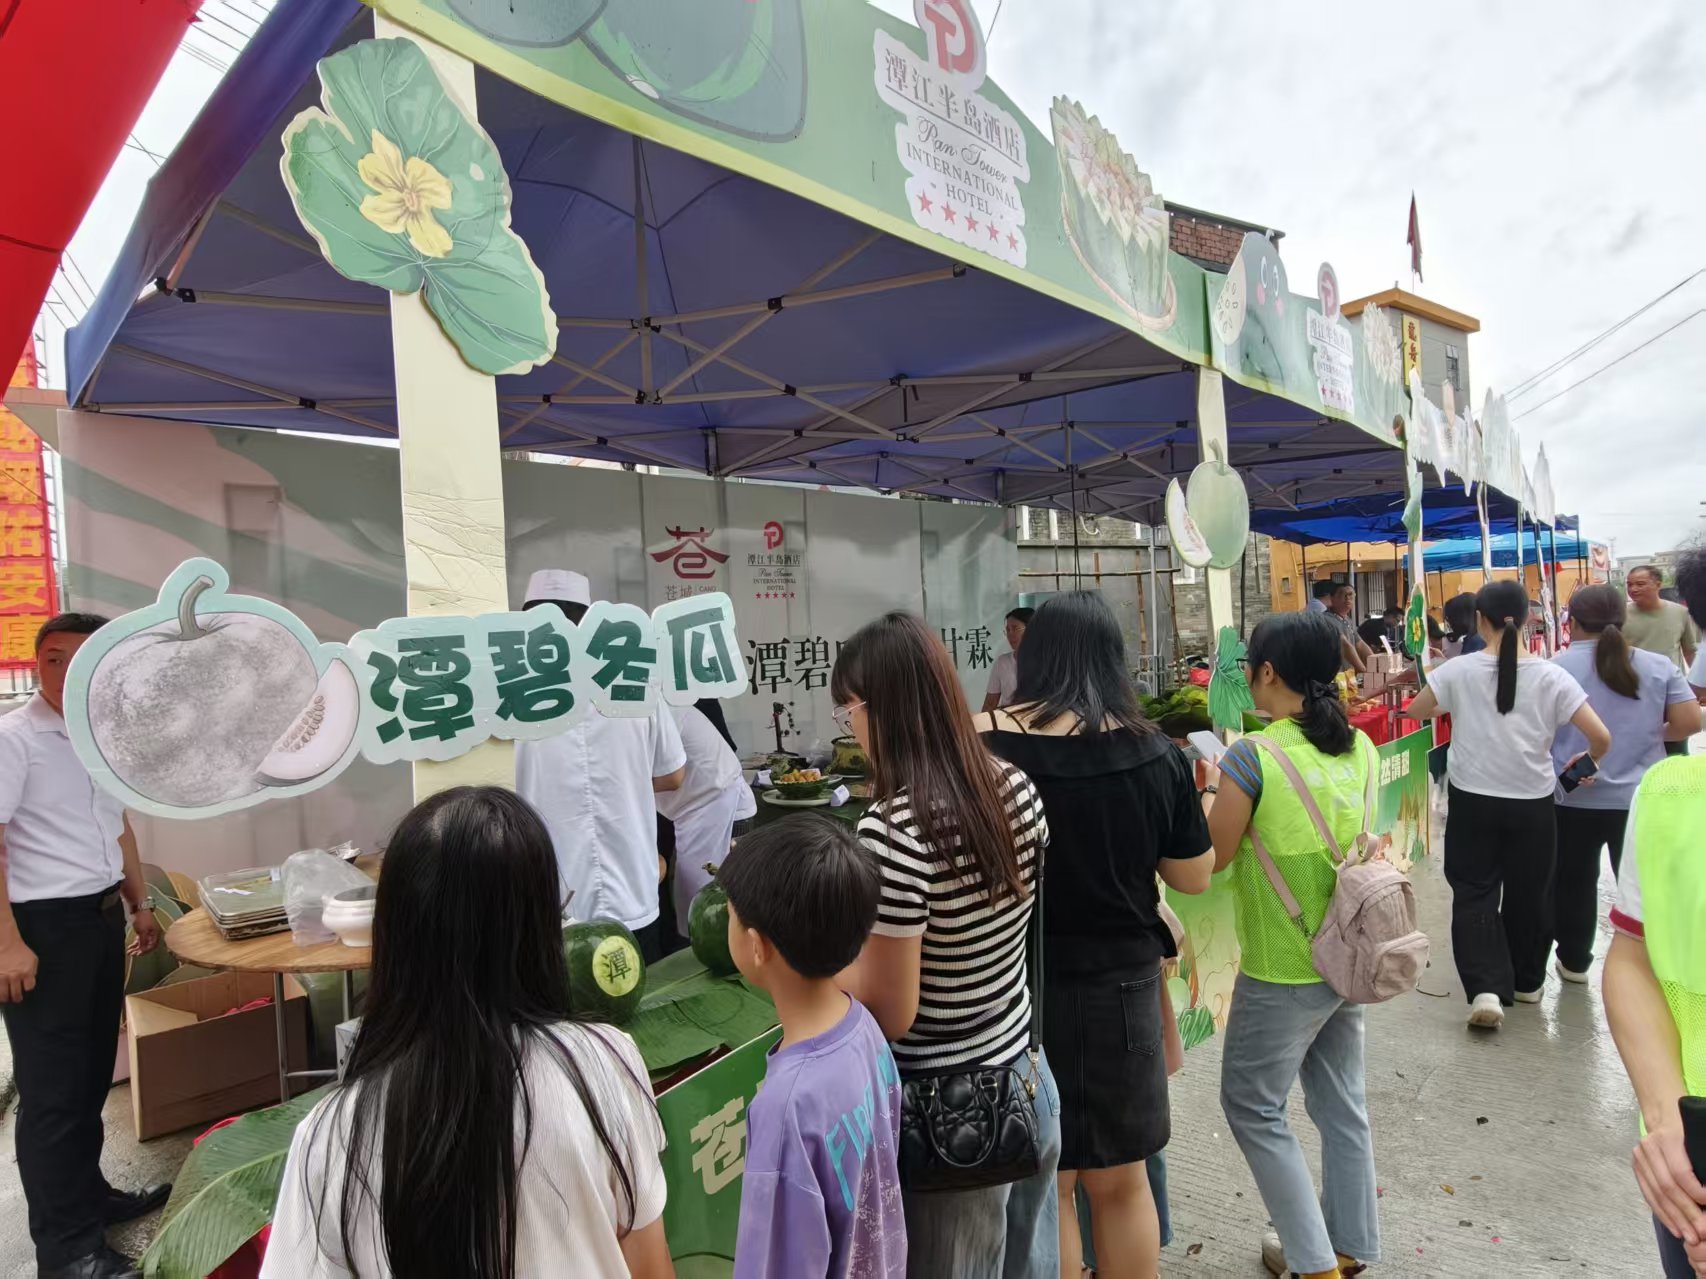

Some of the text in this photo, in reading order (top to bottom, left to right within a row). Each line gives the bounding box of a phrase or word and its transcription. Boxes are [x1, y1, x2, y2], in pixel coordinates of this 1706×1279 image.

[906, 142, 1018, 211] INTERNATIONAL
[916, 115, 1008, 184] Pan Tower
[946, 182, 992, 217] HOTEL
[366, 606, 737, 745] 潭碧冬瓜
[745, 635, 847, 696] 潭碧
[601, 947, 631, 984] 潭
[690, 1081, 764, 1195] 苍
